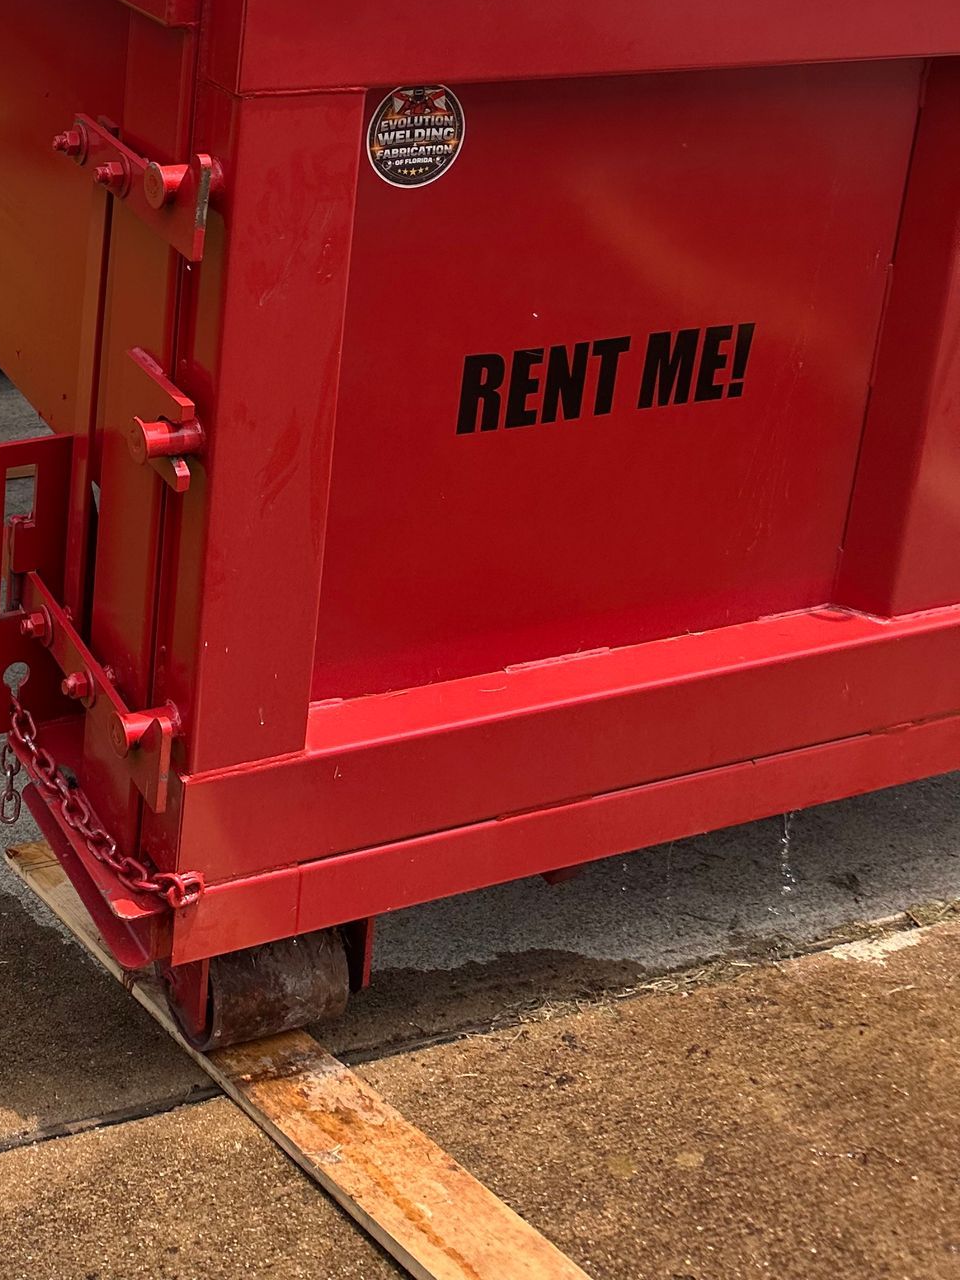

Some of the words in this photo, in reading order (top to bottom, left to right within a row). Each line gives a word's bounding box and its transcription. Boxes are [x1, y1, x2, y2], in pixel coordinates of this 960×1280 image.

[380, 115, 454, 132] EVOLUTION
[378, 127, 455, 146] WELDING
[376, 144, 453, 160] FABRICATION
[405, 157, 433, 165] FLORIDA
[456, 336, 632, 435] RENT
[636, 322, 756, 410] ME!
